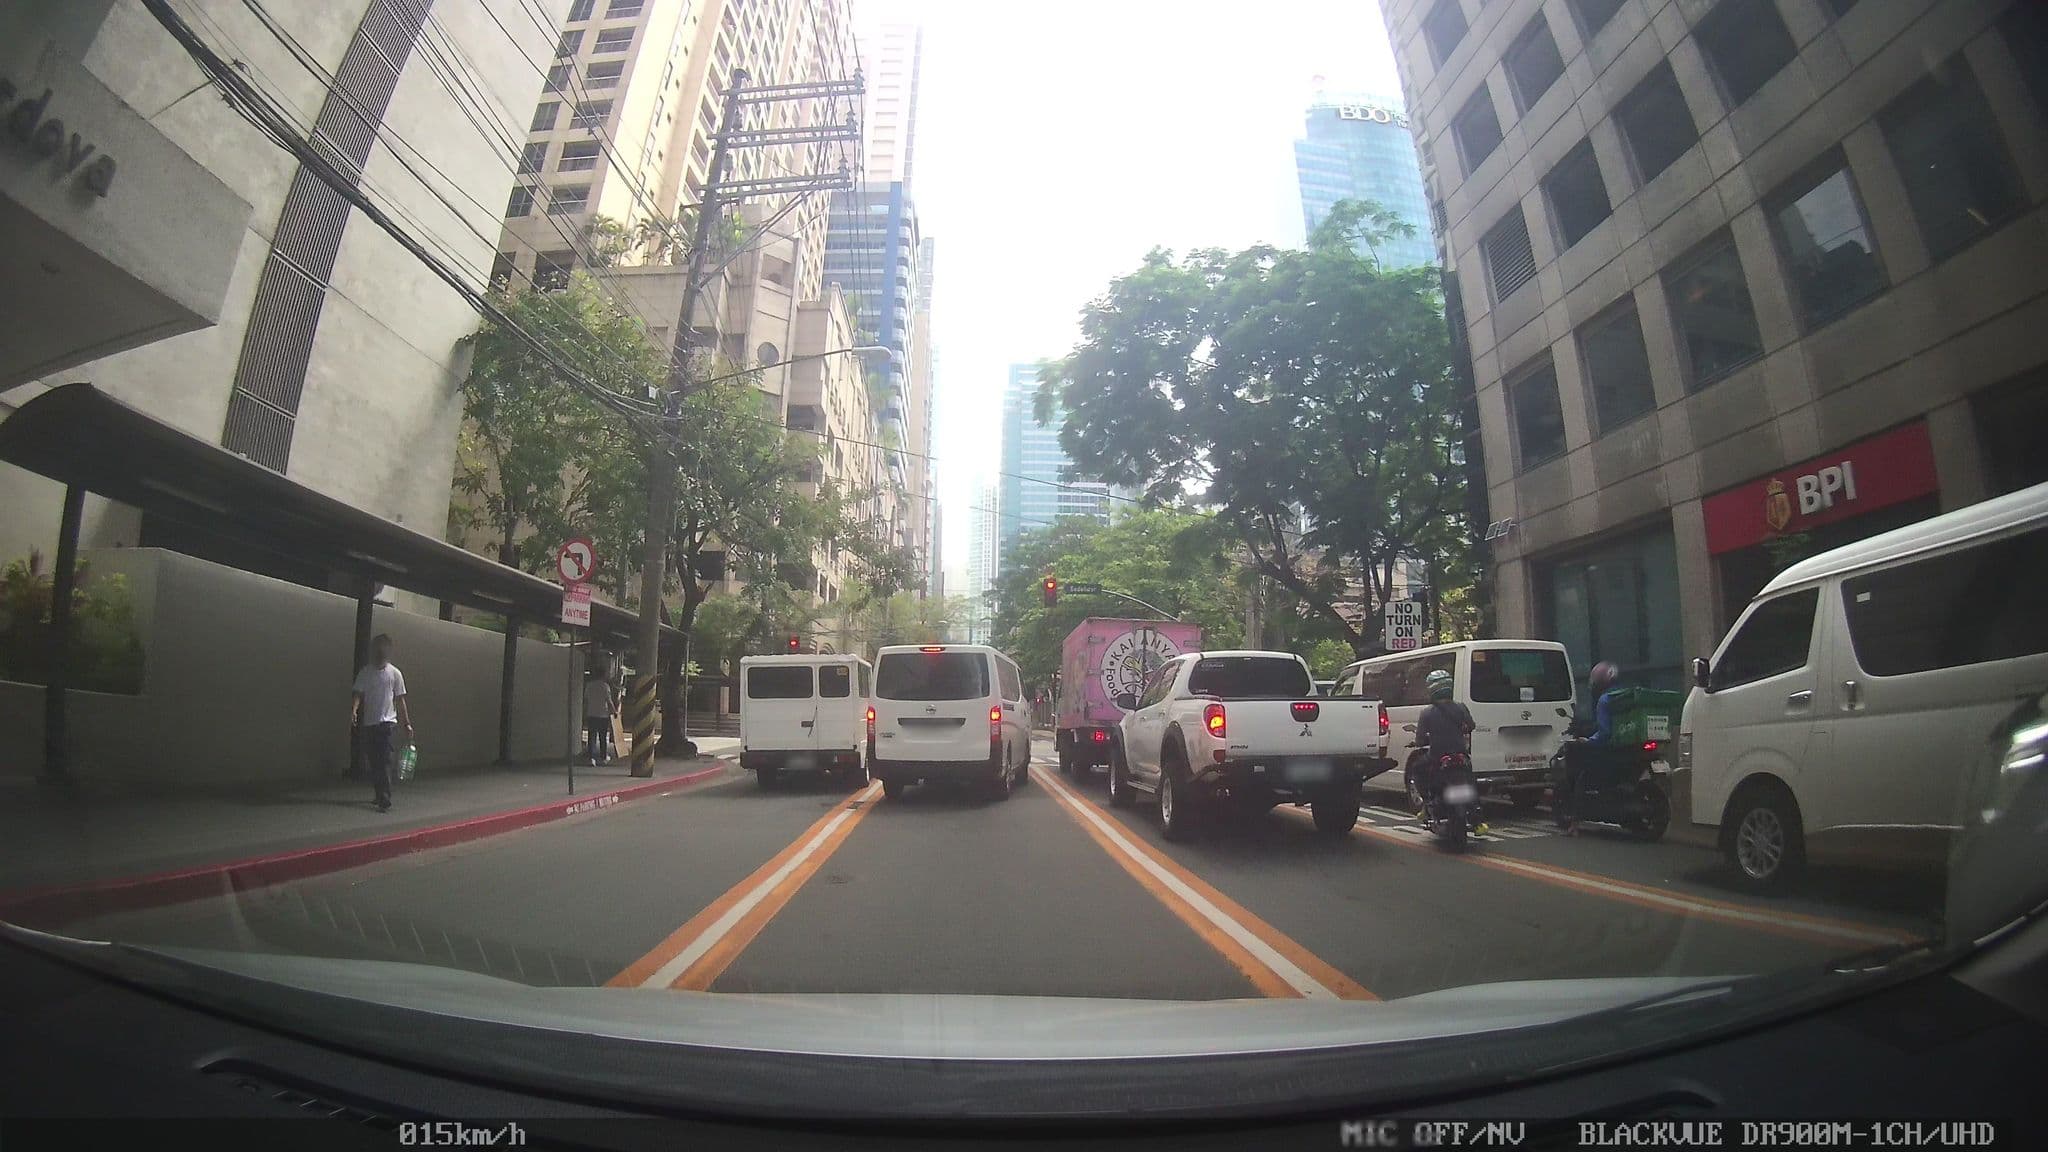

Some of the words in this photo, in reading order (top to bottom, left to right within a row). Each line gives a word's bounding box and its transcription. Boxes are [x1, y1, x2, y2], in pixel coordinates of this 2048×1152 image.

[1340, 106, 1391, 124] BDO
[1796, 460, 1857, 515] BPI
[564, 607, 589, 619] ANYTIME
[1394, 603, 1413, 614] NO
[1386, 614, 1421, 626] TURN
[1395, 626, 1413, 637] ON
[1110, 638, 1134, 661] KAI
[1391, 638, 1417, 649] RED
